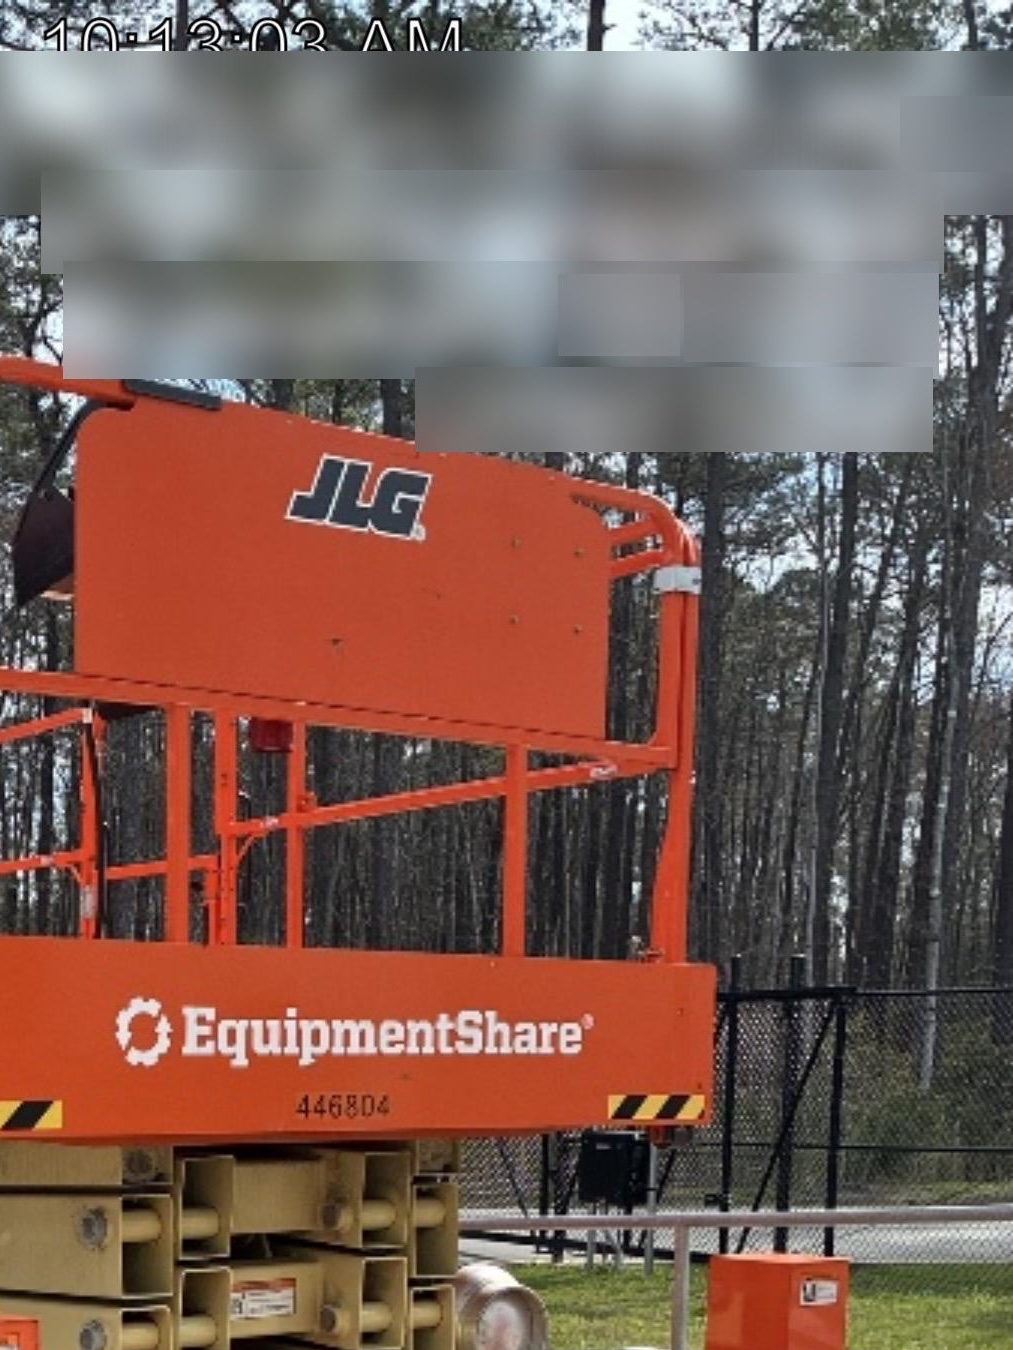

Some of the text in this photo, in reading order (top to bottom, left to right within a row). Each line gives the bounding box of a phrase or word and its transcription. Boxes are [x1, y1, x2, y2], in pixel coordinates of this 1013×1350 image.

[284, 453, 433, 541] JLG
[181, 1007, 584, 1067] EquipmentShare
[295, 1094, 390, 1119] 446804
